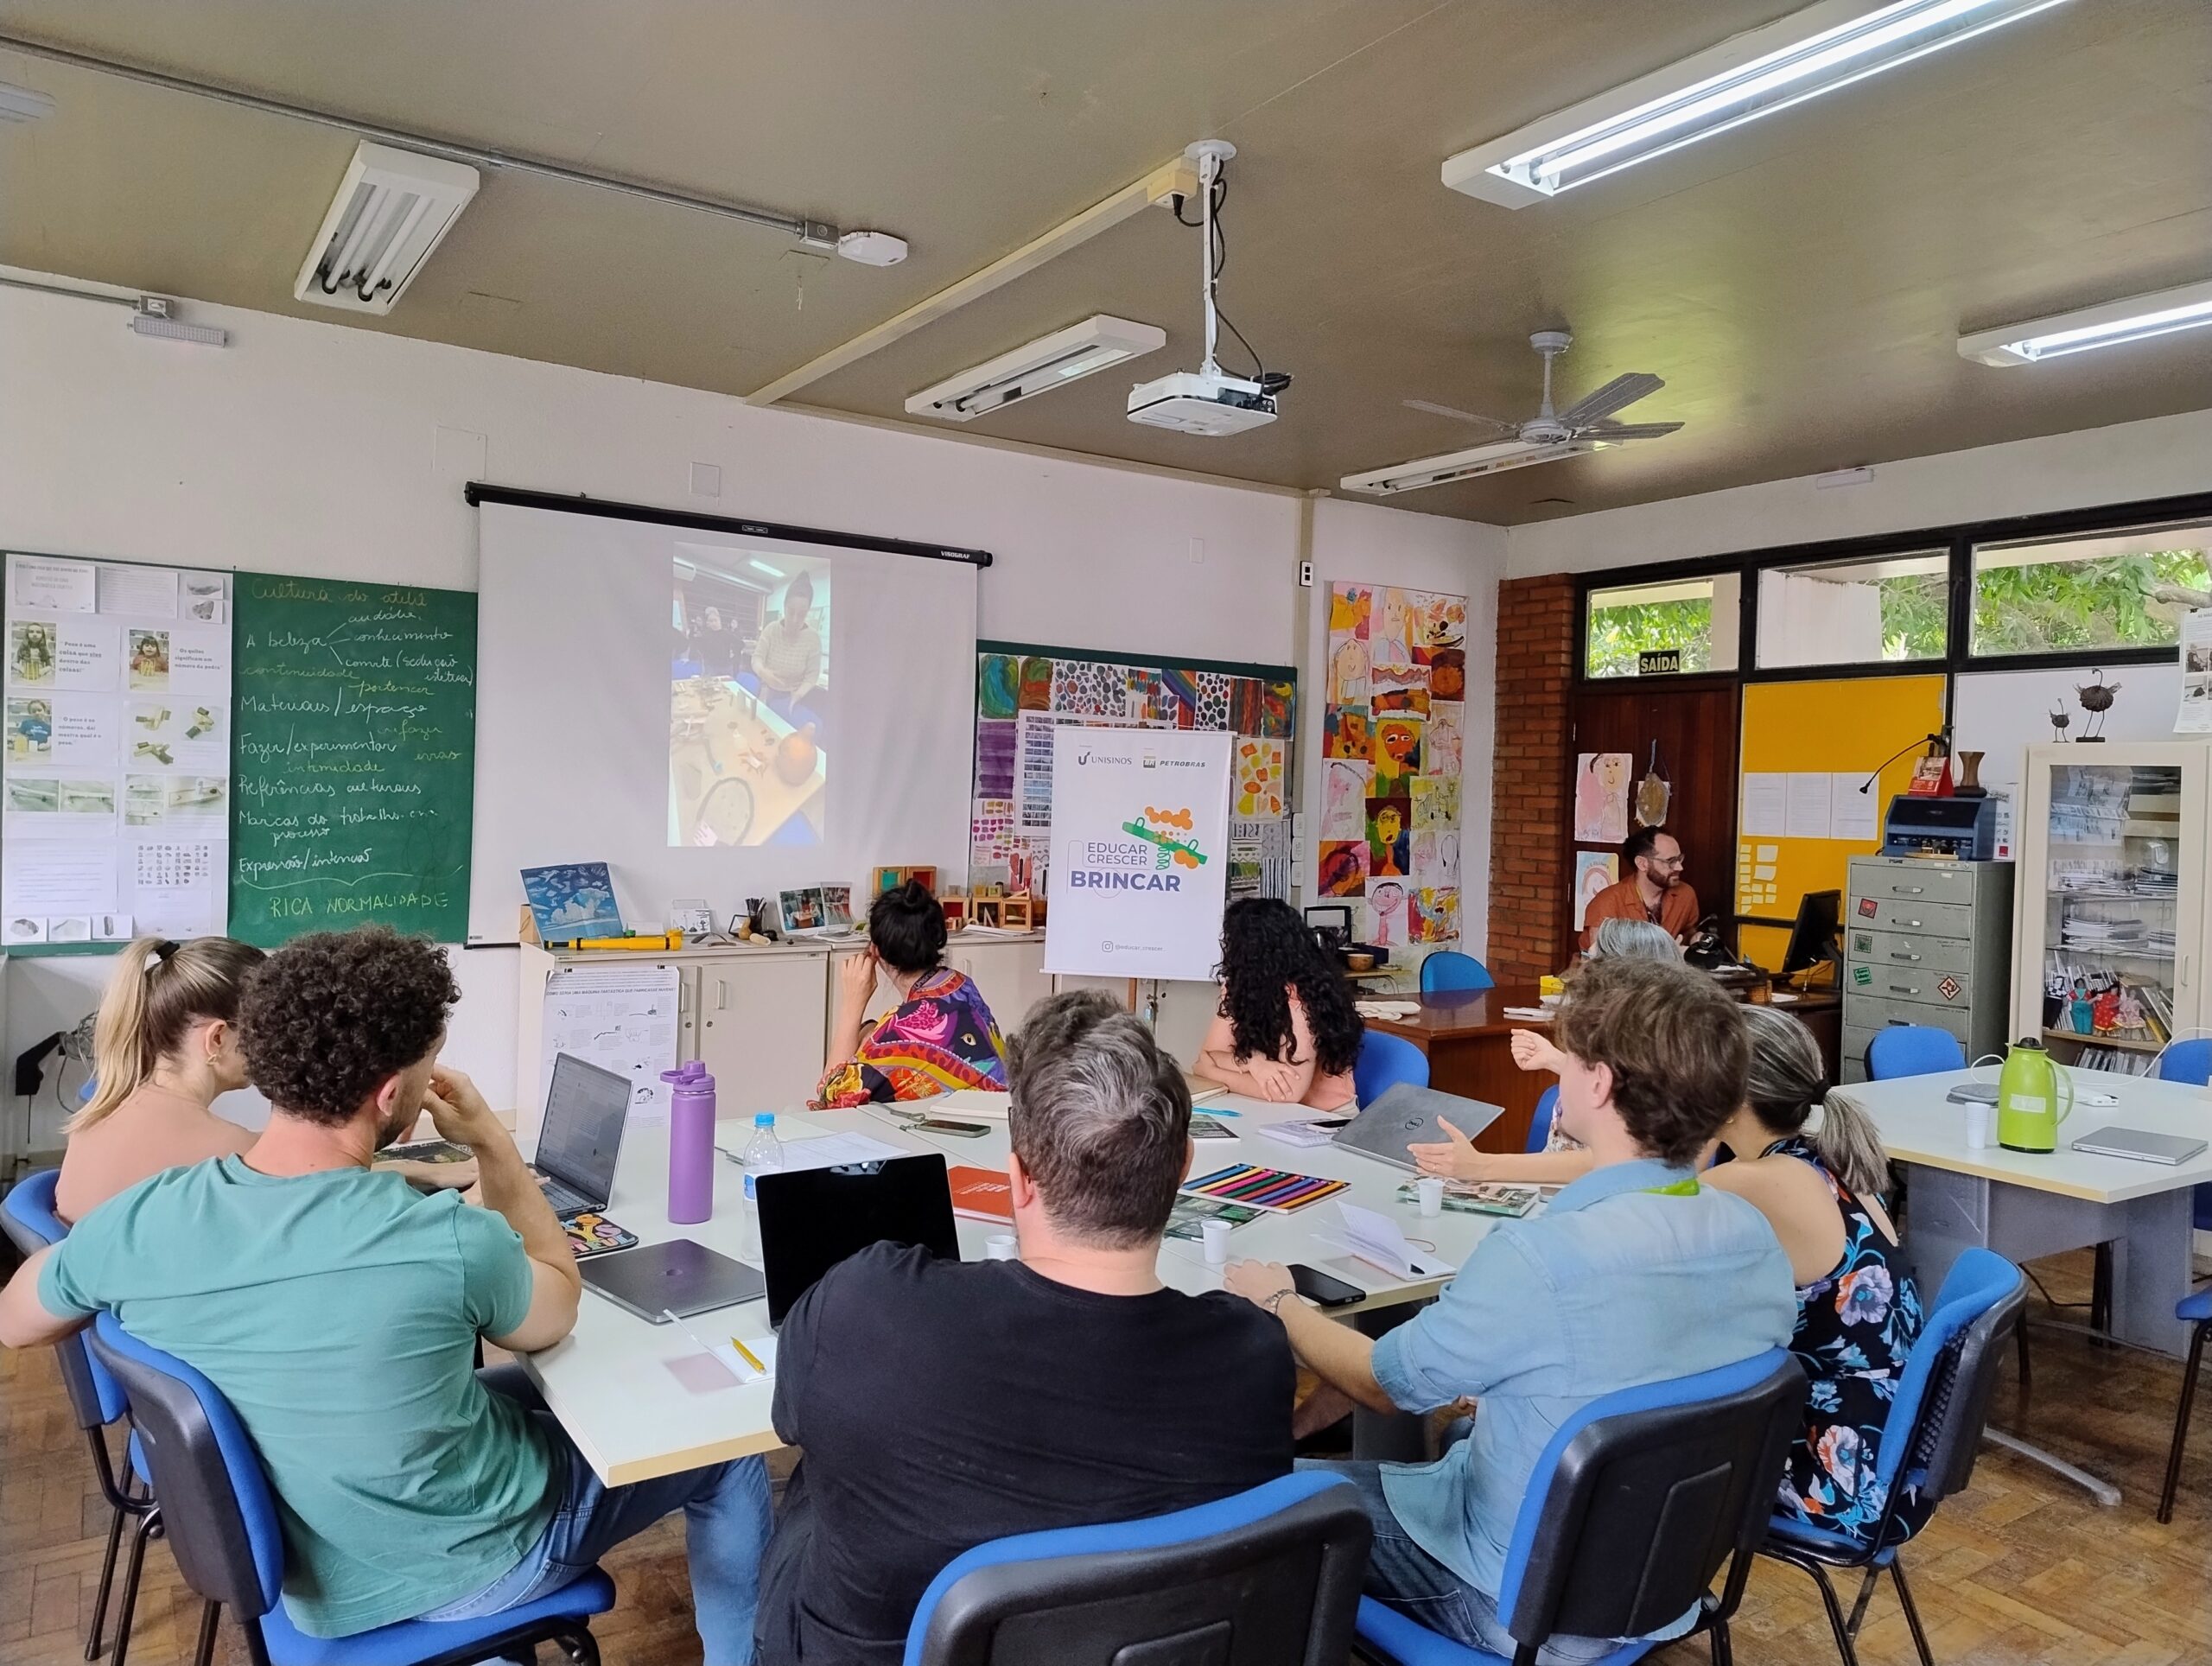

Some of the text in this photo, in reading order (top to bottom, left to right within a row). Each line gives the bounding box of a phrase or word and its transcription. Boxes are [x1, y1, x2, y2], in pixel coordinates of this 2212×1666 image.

[940, 550, 970, 559] VISOGRAF
[353, 626, 454, 641] conhecimento
[246, 631, 327, 654] A beleza
[1640, 653, 1679, 674] SAÍDA
[1091, 755, 1132, 765] UNISINOS
[239, 810, 299, 827] Marcas
[1087, 842, 1147, 855] EDUCAR
[1087, 854, 1147, 866] CRESCER
[1071, 870, 1181, 892] BRINCAR
[270, 892, 448, 918] RICA NORMALIDADE
